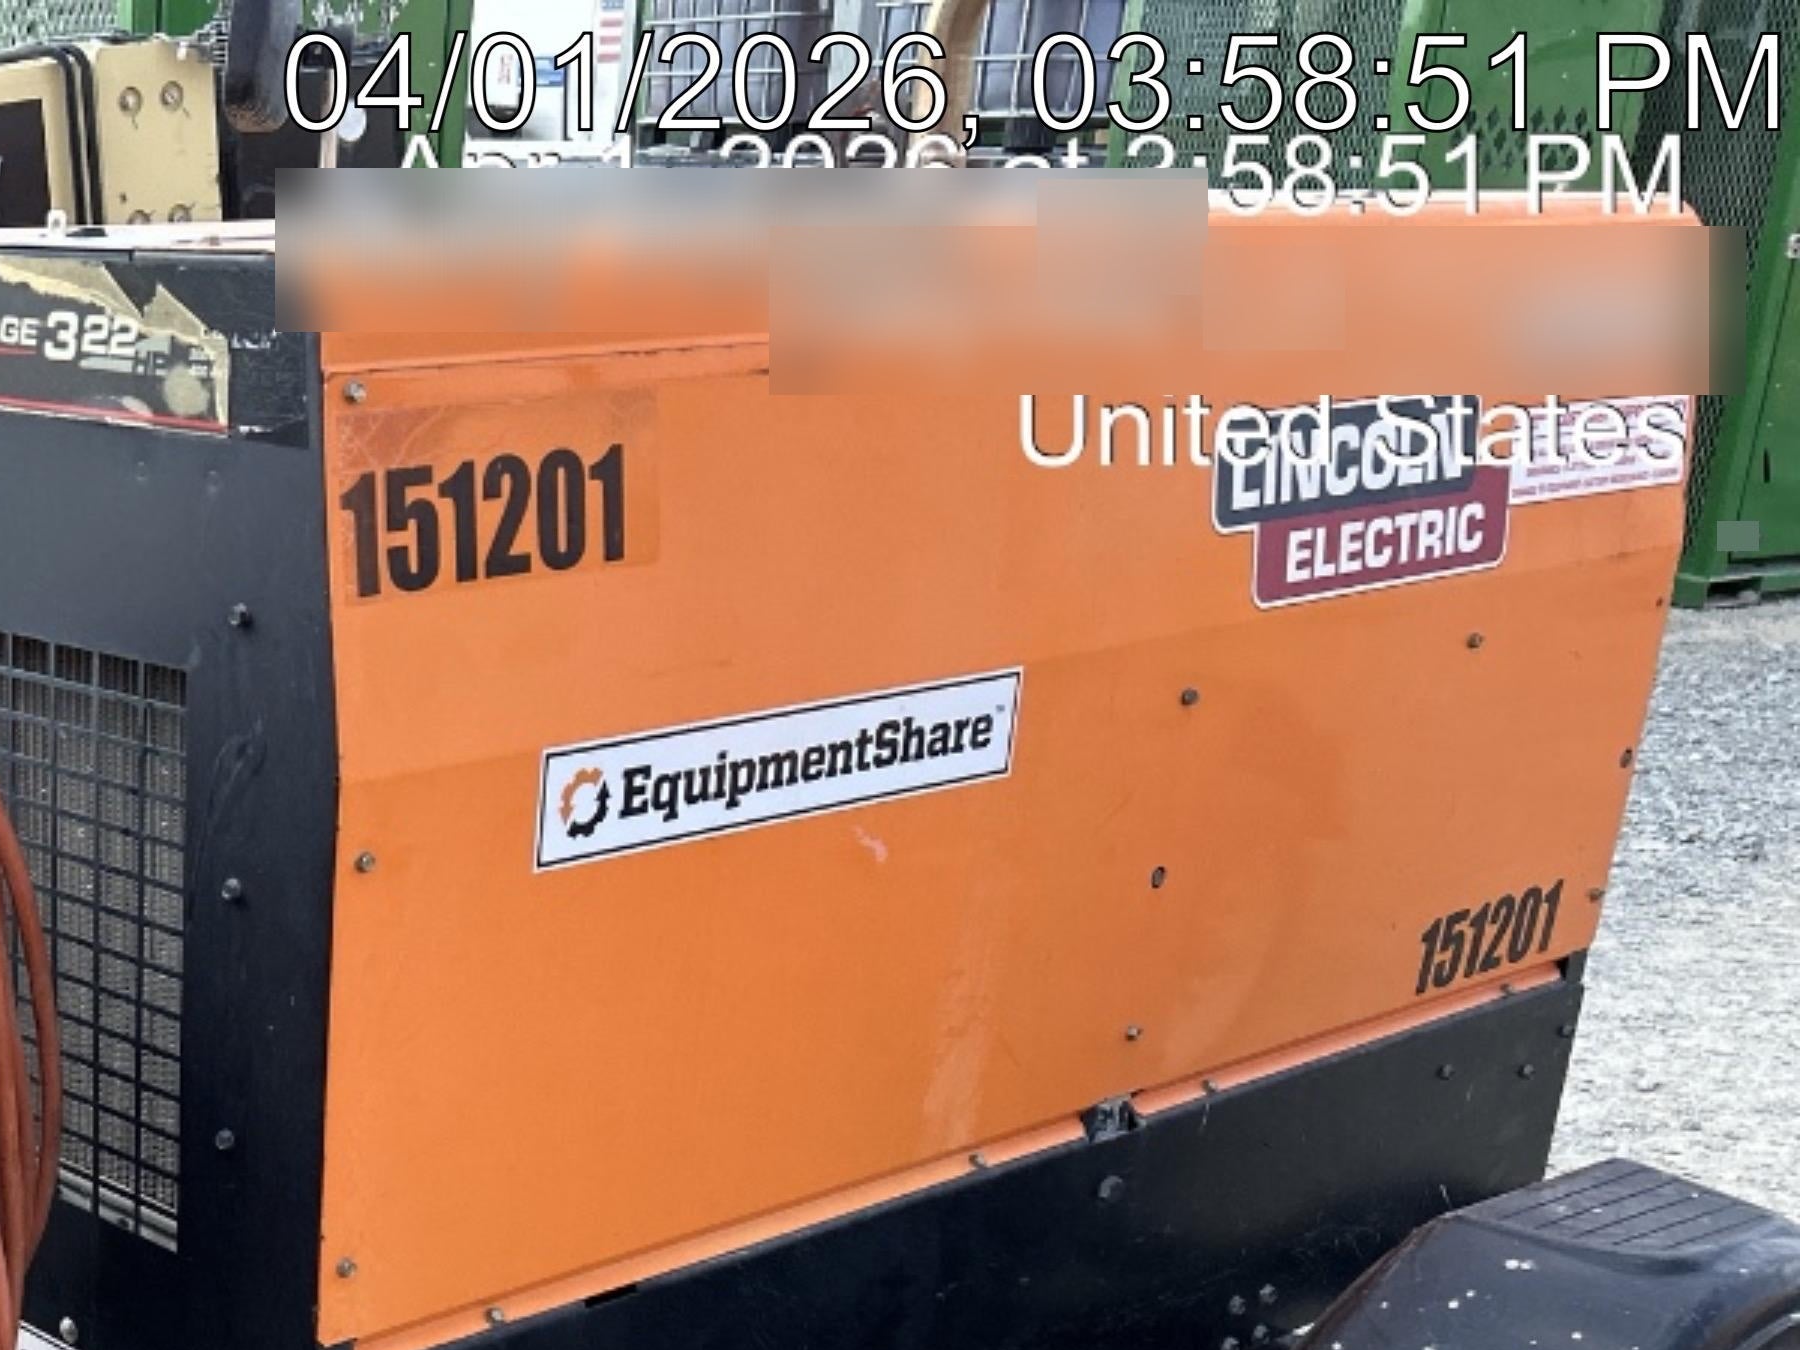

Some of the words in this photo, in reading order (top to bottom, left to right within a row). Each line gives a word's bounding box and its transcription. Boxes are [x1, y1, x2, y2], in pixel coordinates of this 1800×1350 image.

[43, 310, 138, 362] 322
[338, 443, 625, 598] 151201
[1286, 501, 1486, 583] ELECTRIC
[1414, 878, 1565, 997] 151201
